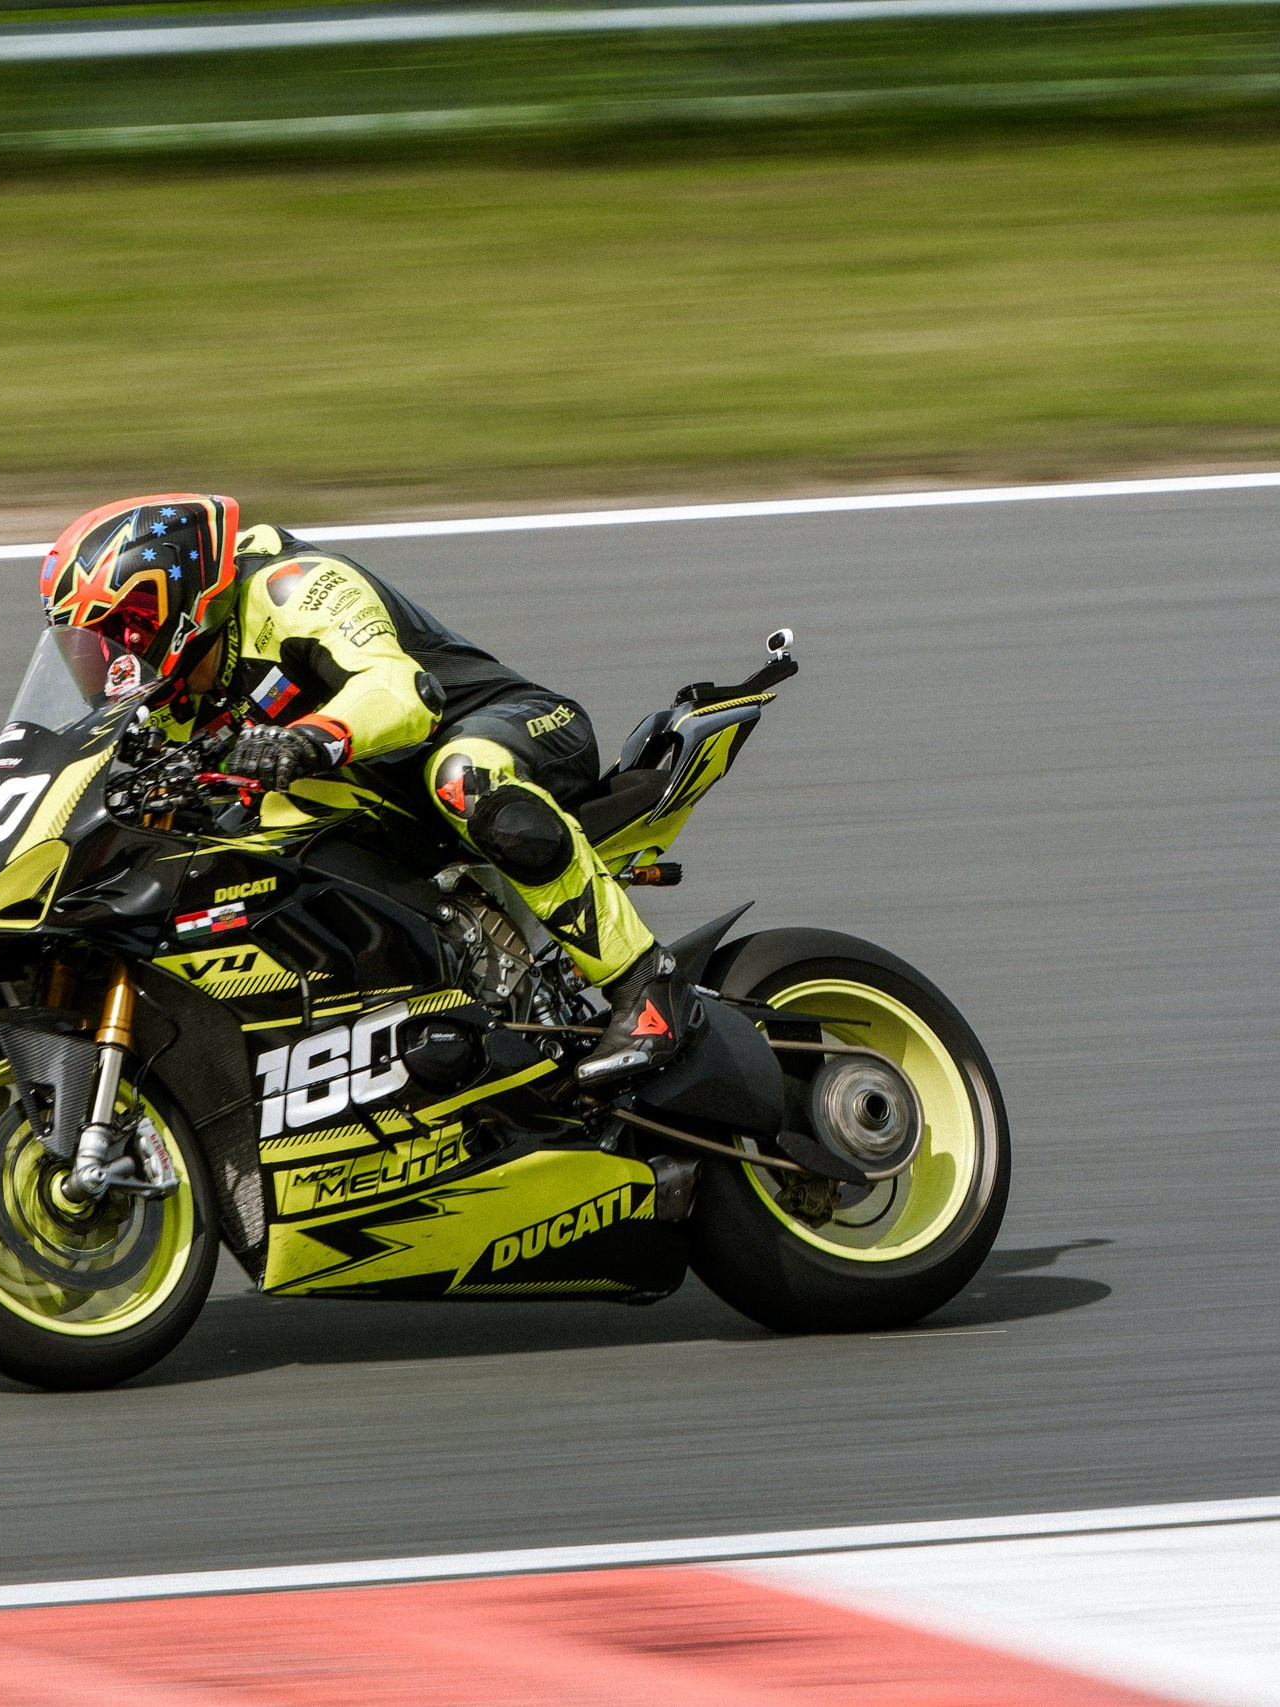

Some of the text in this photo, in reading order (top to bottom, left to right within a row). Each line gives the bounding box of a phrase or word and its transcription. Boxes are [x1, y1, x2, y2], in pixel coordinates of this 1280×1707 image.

[310, 576, 347, 611] WORKS
[221, 609, 239, 687] DAINES
[526, 704, 576, 738] DAINESE
[214, 876, 277, 903] DUCATI
[182, 952, 261, 981] V4
[256, 1001, 410, 1139] 160
[150, 1132, 171, 1171] brembo
[317, 1139, 458, 1203] МЕЧТА
[492, 1184, 632, 1273] DUCATI
